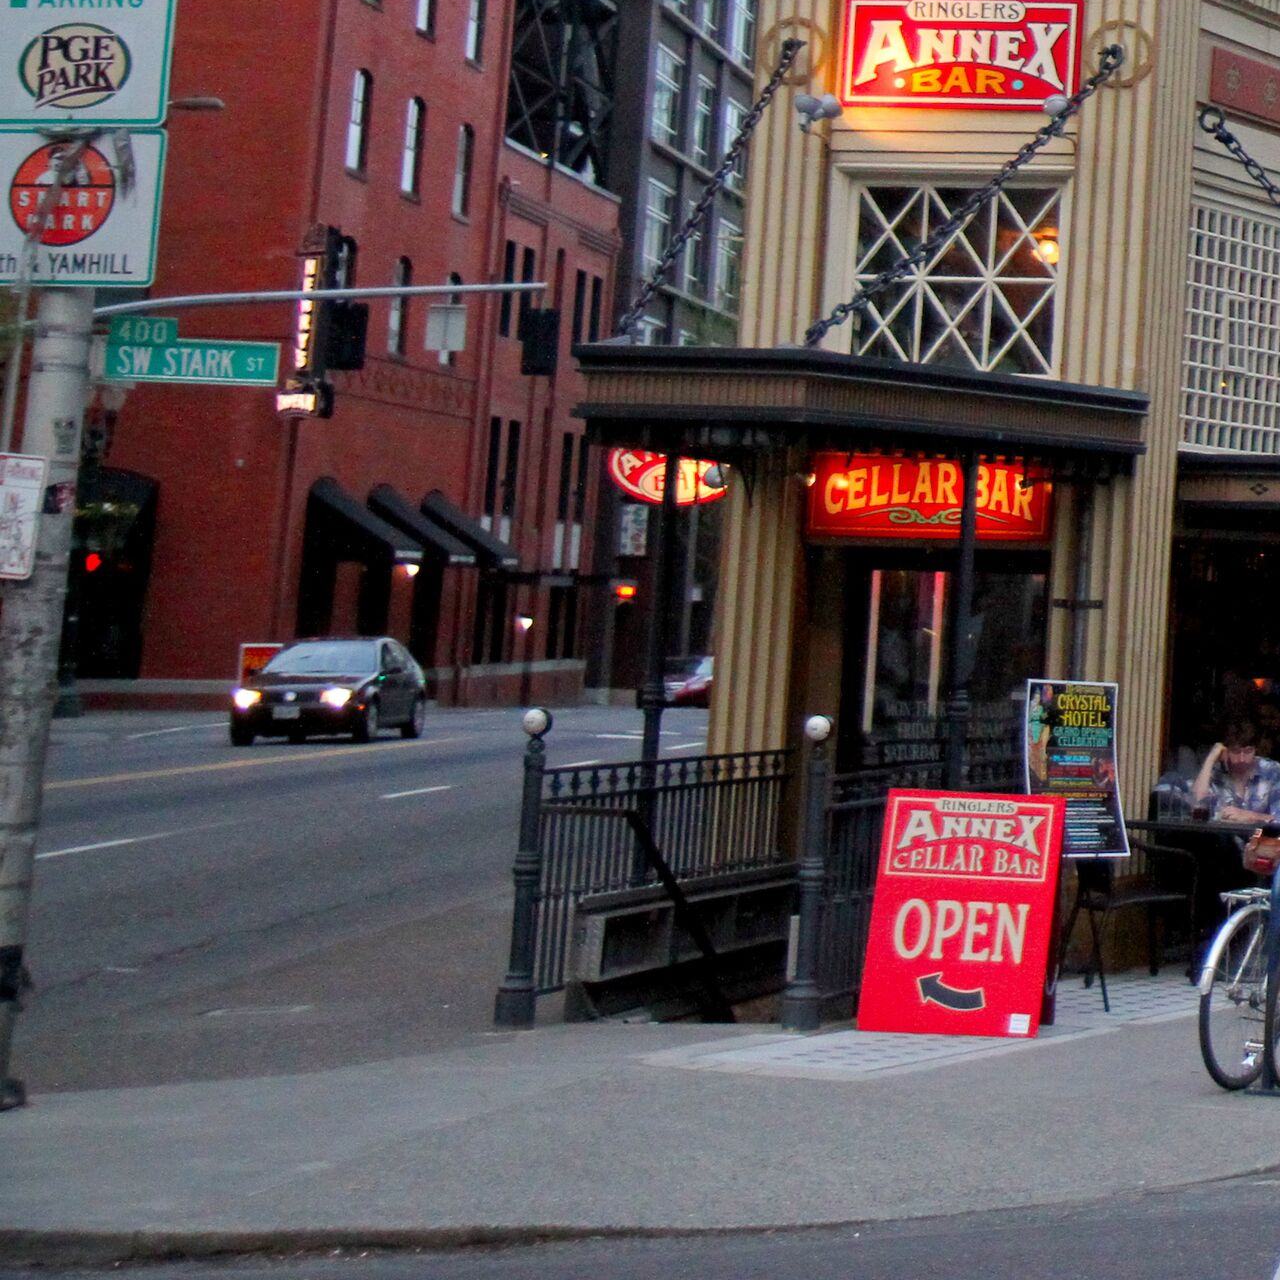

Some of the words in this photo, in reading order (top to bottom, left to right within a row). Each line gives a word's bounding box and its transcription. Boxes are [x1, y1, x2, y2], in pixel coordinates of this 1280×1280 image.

[912, 0, 1021, 21] RINGLERS
[38, 35, 116, 72] PGE
[854, 19, 1070, 91] ANNEX
[36, 62, 118, 104] PARK
[911, 67, 1007, 95] BAR
[48, 253, 133, 274] YAMHILL
[118, 321, 168, 343] 400
[116, 345, 152, 374] SW
[162, 349, 236, 378] STARK
[246, 357, 265, 372] ST
[824, 461, 958, 515] CELLAR
[974, 464, 1034, 521] BAR
[1057, 694, 1111, 711] CRYSTAL
[1059, 711, 1107, 728] HOTEL
[941, 799, 1016, 814] RINGLERS
[897, 811, 1047, 856] ANNEX
[893, 844, 984, 872] CELLAR
[993, 849, 1041, 877] BAR
[893, 897, 1031, 965] OPEN
